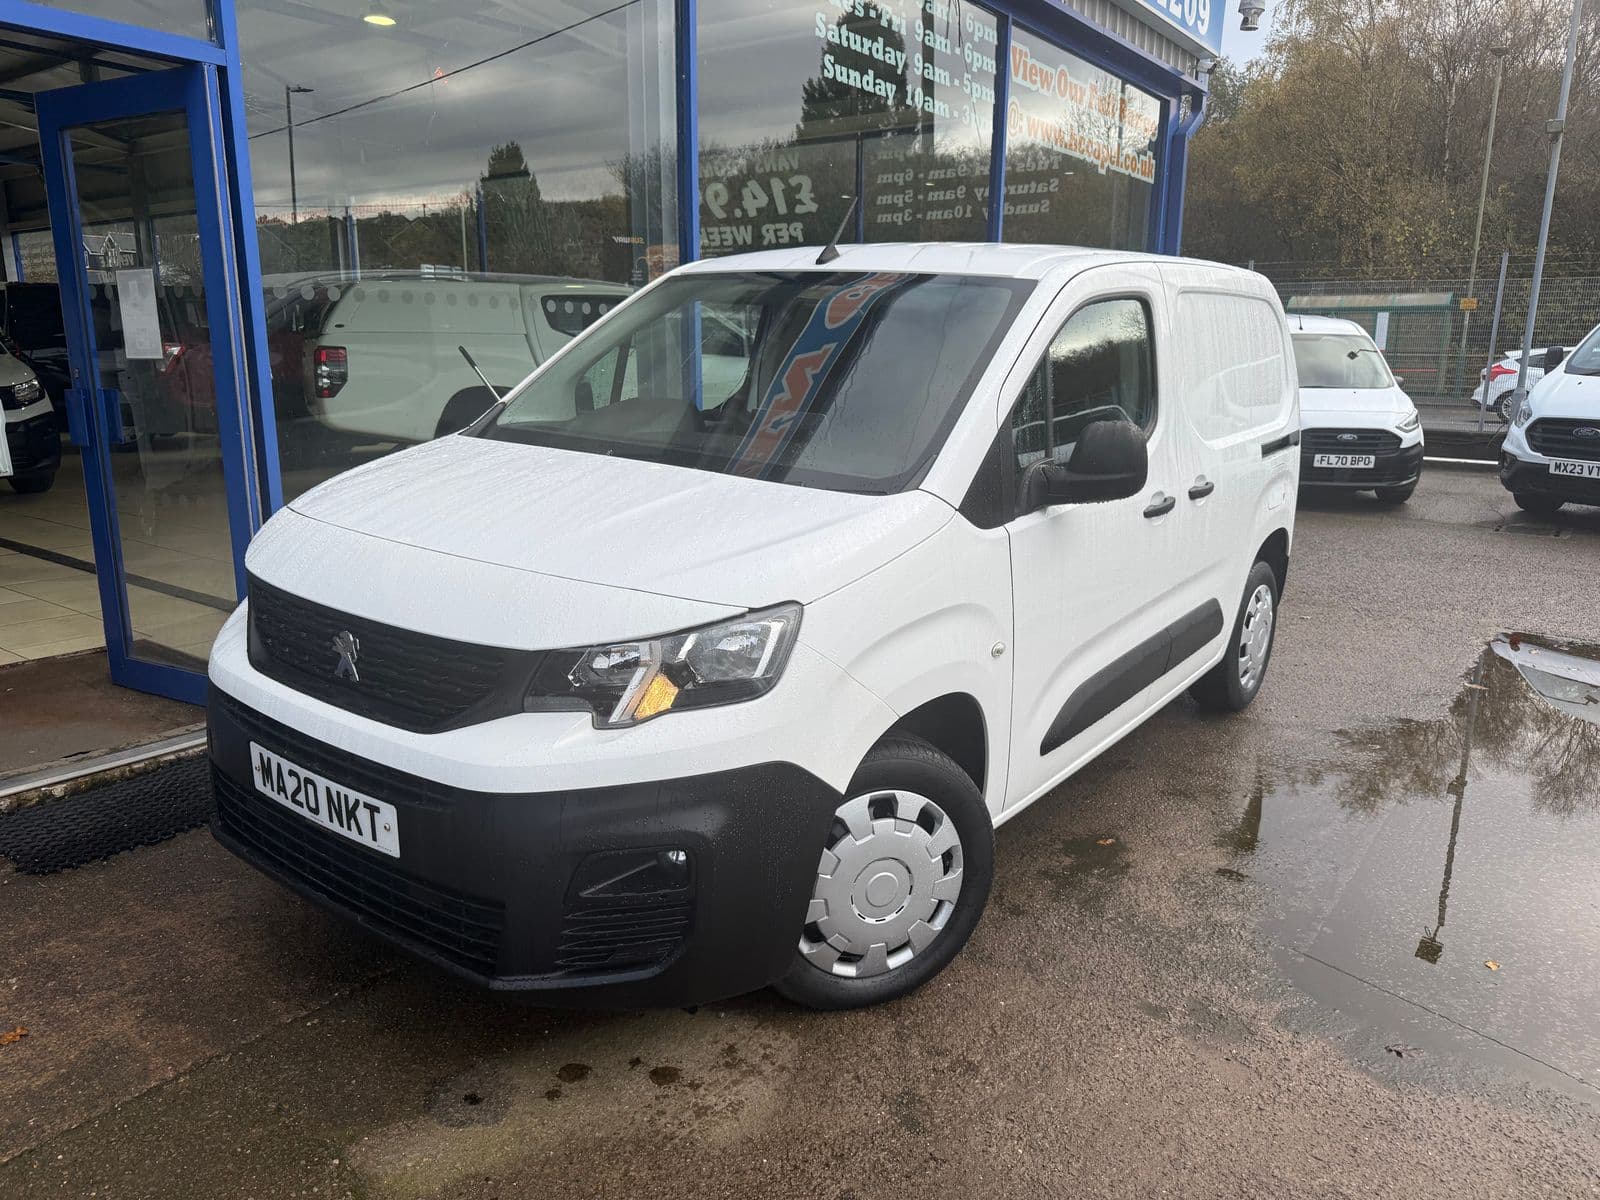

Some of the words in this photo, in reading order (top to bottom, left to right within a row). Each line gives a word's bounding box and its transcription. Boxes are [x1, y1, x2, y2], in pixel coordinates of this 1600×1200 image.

[880, 4, 906, 35] Fri
[914, 20, 951, 56] 9am
[964, 42, 997, 75] 6pm
[966, 13, 998, 46] 6pm
[1156, 0, 1210, 35] 09
[815, 12, 906, 75] Saturday
[914, 53, 951, 88] 9am
[962, 72, 995, 104] 5pm
[1011, 44, 1055, 93] View
[1057, 66, 1087, 107] Our
[823, 53, 897, 106] Sunday
[905, 84, 950, 119] 10am
[962, 104, 994, 132] 3pm
[1320, 455, 1347, 466] FL70
[1350, 456, 1371, 466] BPO
[1554, 461, 1584, 475] MX23
[259, 751, 320, 817] MA20
[325, 785, 381, 842] NKT
